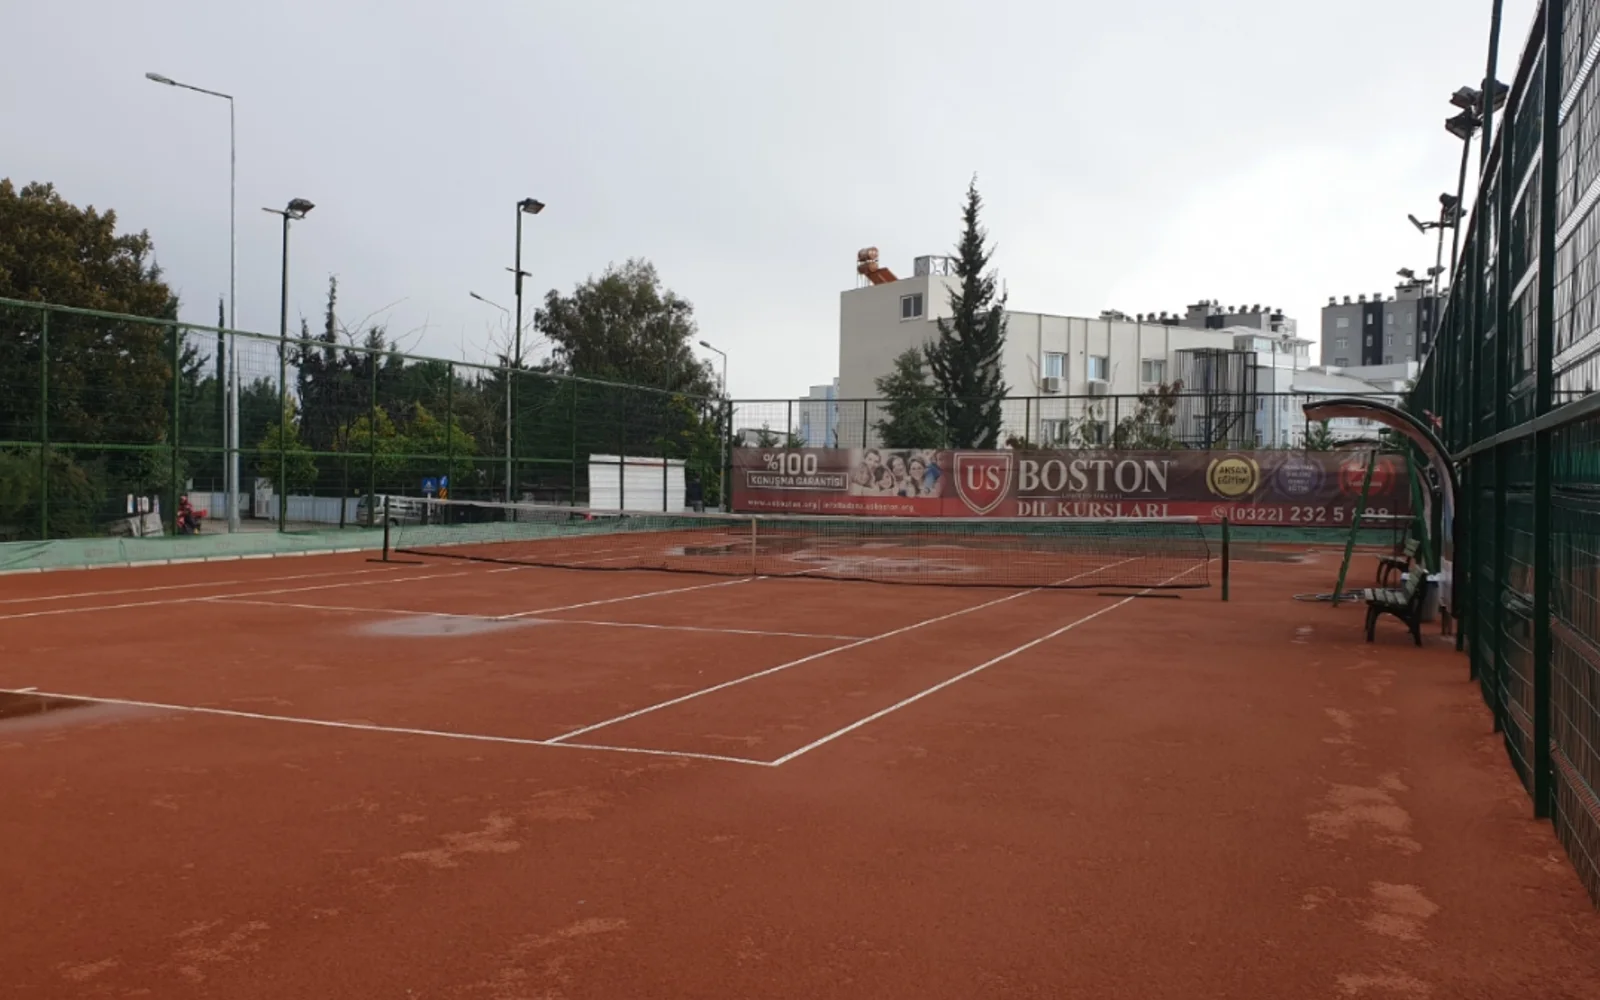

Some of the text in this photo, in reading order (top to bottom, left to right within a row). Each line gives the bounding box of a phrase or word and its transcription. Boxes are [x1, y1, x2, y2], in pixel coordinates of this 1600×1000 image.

[763, 452, 818, 475] %100
[1219, 466, 1248, 475] AKSAN
[751, 475, 843, 487] KONUŞMA GARANTİSİ
[966, 464, 1001, 490] US
[1018, 459, 1170, 493] BOSTON
[1017, 502, 1169, 518] DİL KURSLARI
[1230, 507, 1283, 522] (0322)
[1290, 506, 1326, 522] 232
[1333, 506, 1344, 522] 5
